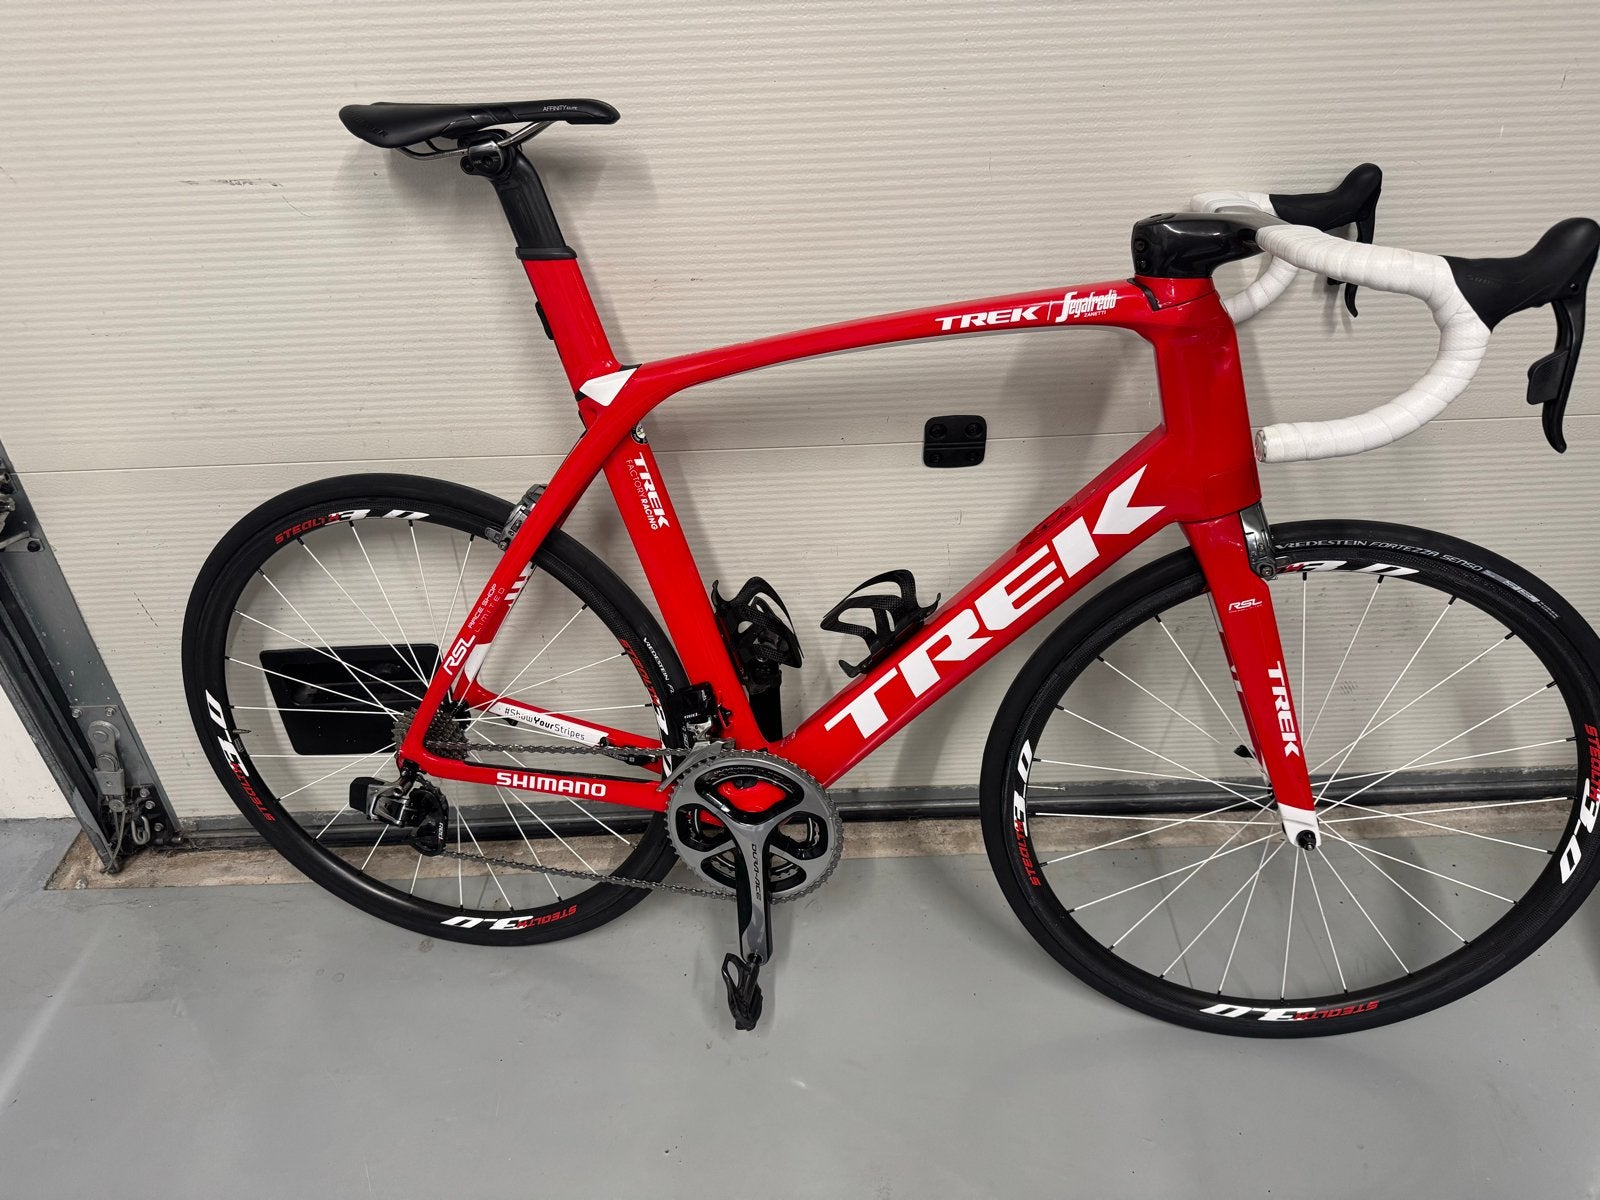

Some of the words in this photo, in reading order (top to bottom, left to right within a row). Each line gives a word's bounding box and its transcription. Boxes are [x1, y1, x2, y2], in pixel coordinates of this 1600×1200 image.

[935, 305, 1042, 331] TREK
[1083, 310, 1107, 318] ZANETTI
[625, 458, 647, 498] FACTORY
[640, 497, 659, 531] RACING
[633, 451, 671, 529] TREK
[1274, 539, 1369, 551] VREDESTEIN
[1368, 540, 1441, 558] FORTEZZA
[1439, 553, 1485, 573] SENSO
[467, 606, 485, 630] RACE
[481, 583, 498, 607] SHOP
[824, 463, 1167, 739] TREK
[1228, 597, 1263, 611] RSL
[443, 634, 477, 676] RSL
[643, 636, 671, 682] VREDESTEIN
[1267, 660, 1301, 759] TREK
[496, 771, 607, 798] SHIMANO
[751, 843, 763, 902] DURA-ACE
